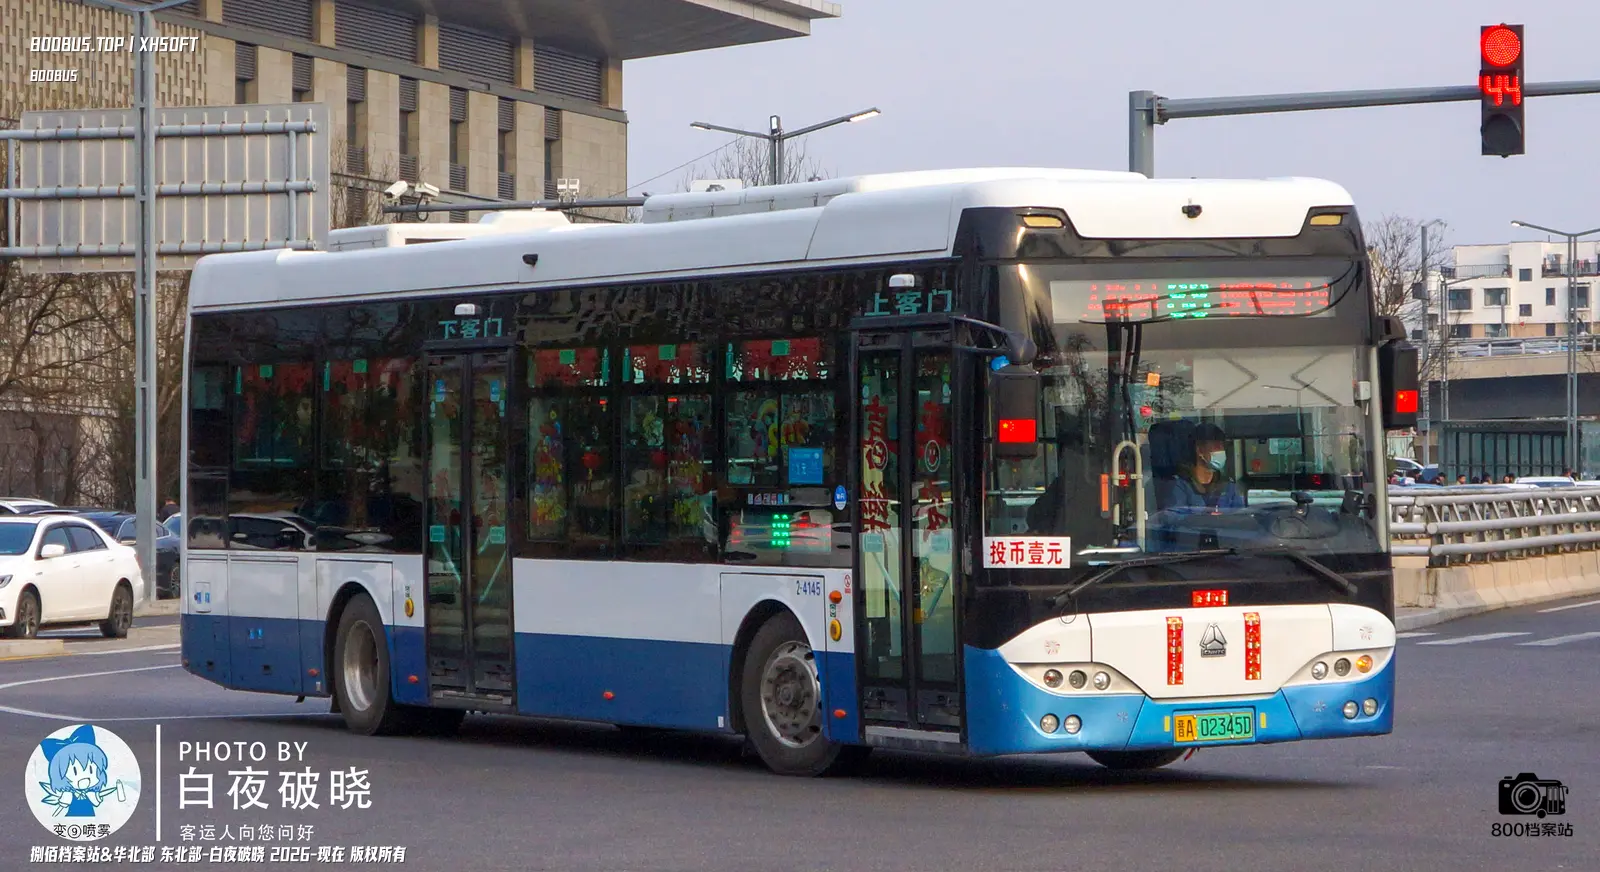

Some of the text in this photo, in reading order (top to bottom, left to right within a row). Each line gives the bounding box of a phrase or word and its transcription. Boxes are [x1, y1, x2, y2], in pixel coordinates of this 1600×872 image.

[1480, 76, 1520, 106] 44
[865, 289, 952, 317] 上客门
[438, 317, 503, 340] 下客门
[989, 540, 1063, 566] 投币壹元
[796, 580, 821, 596] 2-4145
[1201, 716, 1251, 737] 02345D
